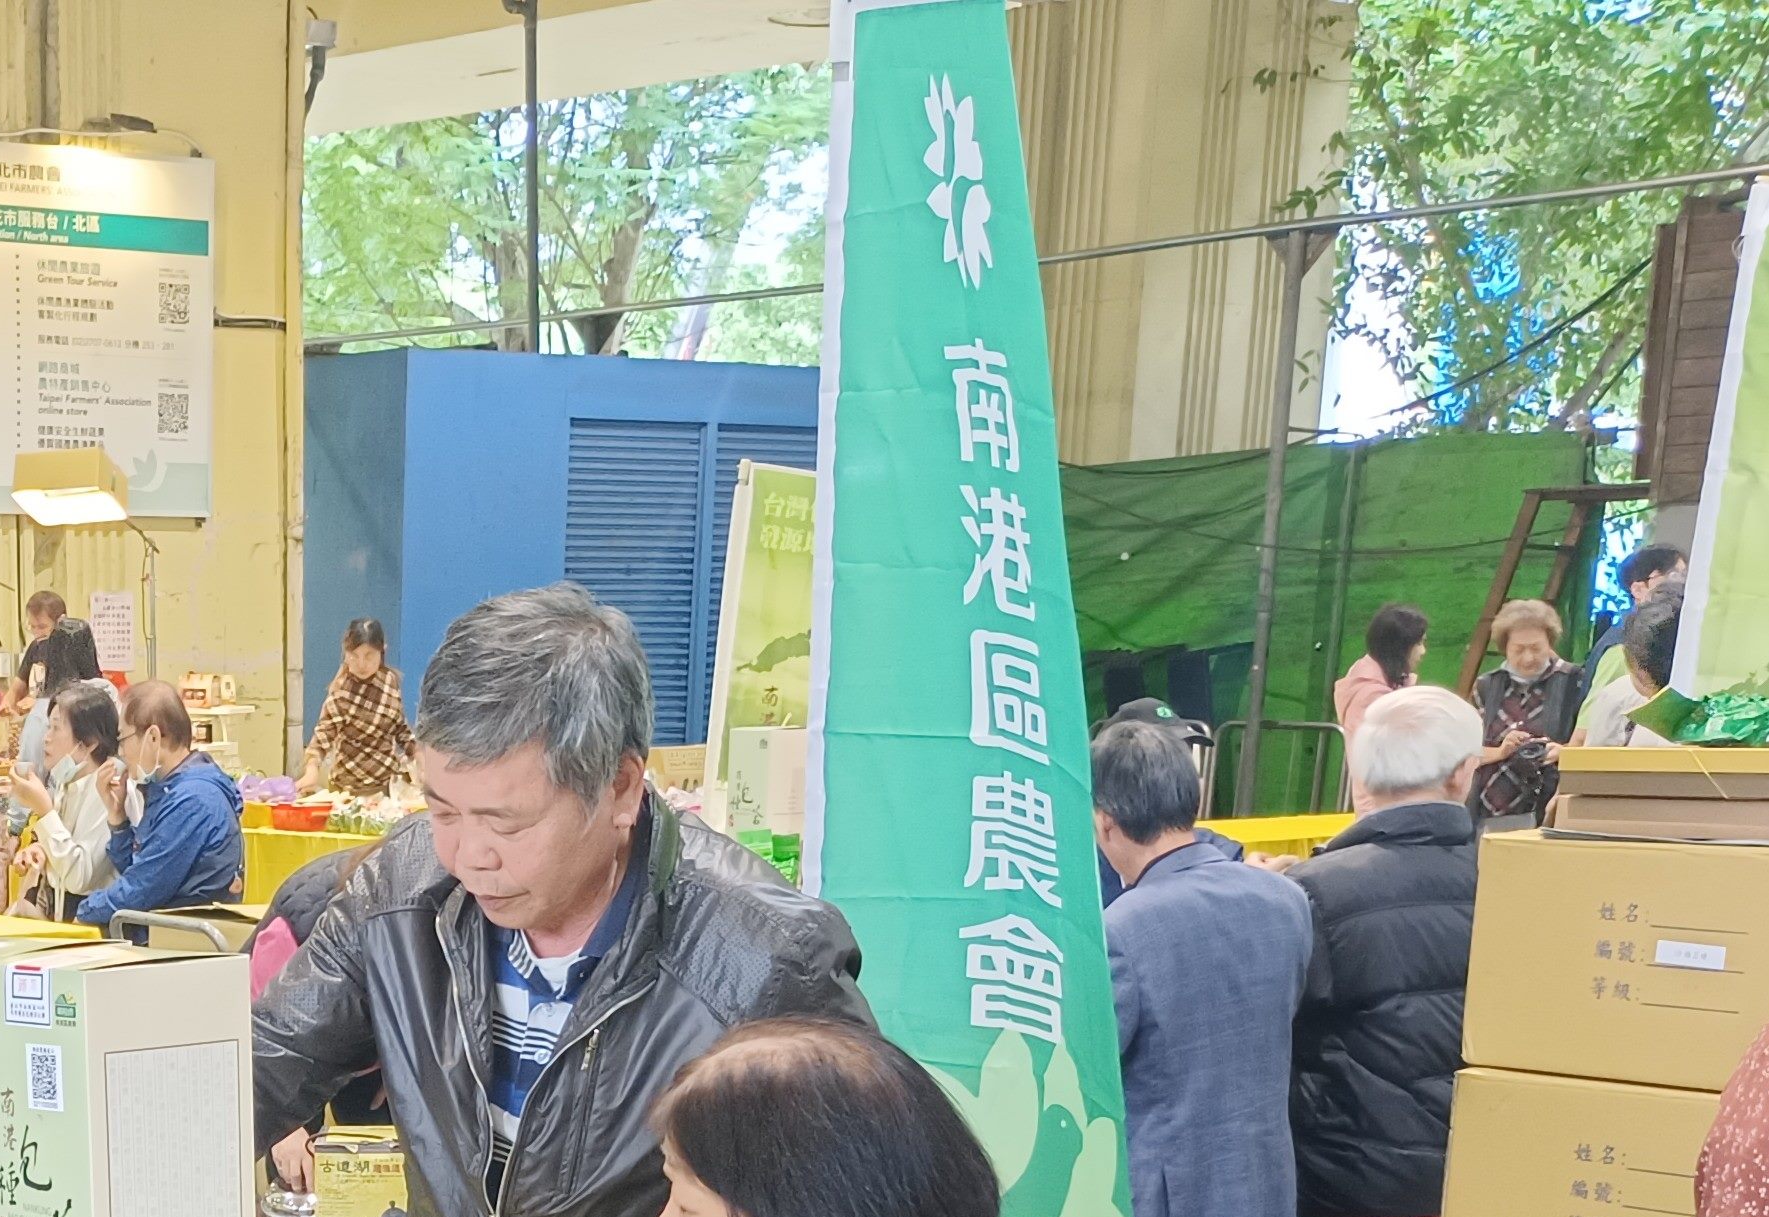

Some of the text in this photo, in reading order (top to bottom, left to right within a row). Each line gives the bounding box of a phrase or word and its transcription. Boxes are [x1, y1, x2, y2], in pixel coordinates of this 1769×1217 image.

[23, 231, 49, 242] North
[37, 274, 118, 288] Green Tour Service
[38, 393, 64, 407] Taipei
[104, 397, 151, 406] Association
[38, 406, 88, 416] online store
[944, 337, 1064, 1044] 南港區農會
[0, 1087, 18, 1151] 南港
